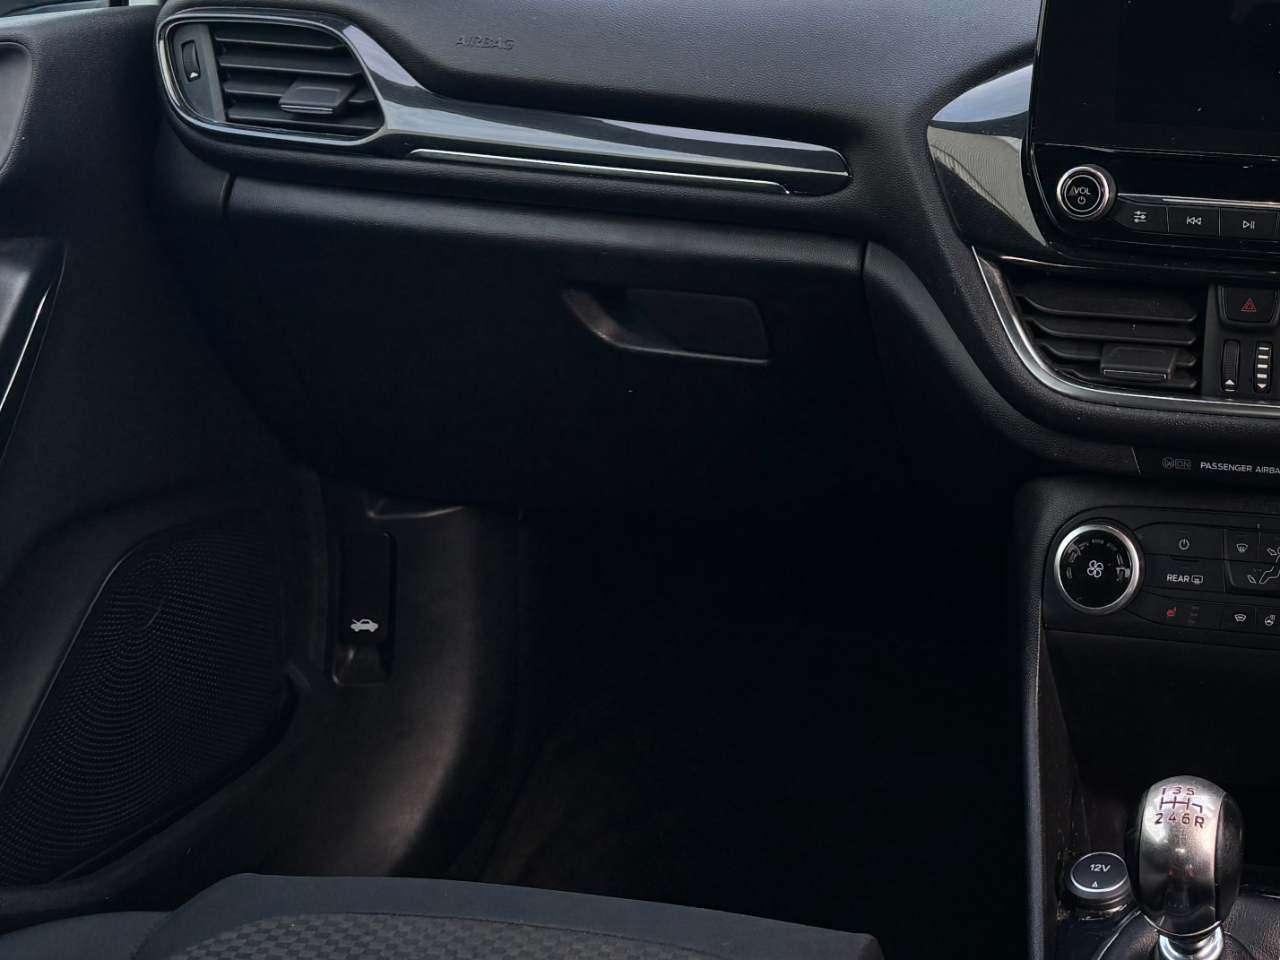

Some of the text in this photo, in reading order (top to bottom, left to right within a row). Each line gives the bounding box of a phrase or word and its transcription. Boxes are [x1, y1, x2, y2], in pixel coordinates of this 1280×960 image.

[1073, 186, 1091, 195] VOL
[1200, 461, 1252, 473] PASSENGER
[1166, 573, 1190, 583] REAR
[1172, 786, 1182, 795] 3
[1186, 787, 1195, 796] 5
[1154, 811, 1205, 829] 2 4 6 R
[1089, 863, 1111, 872] 12V
